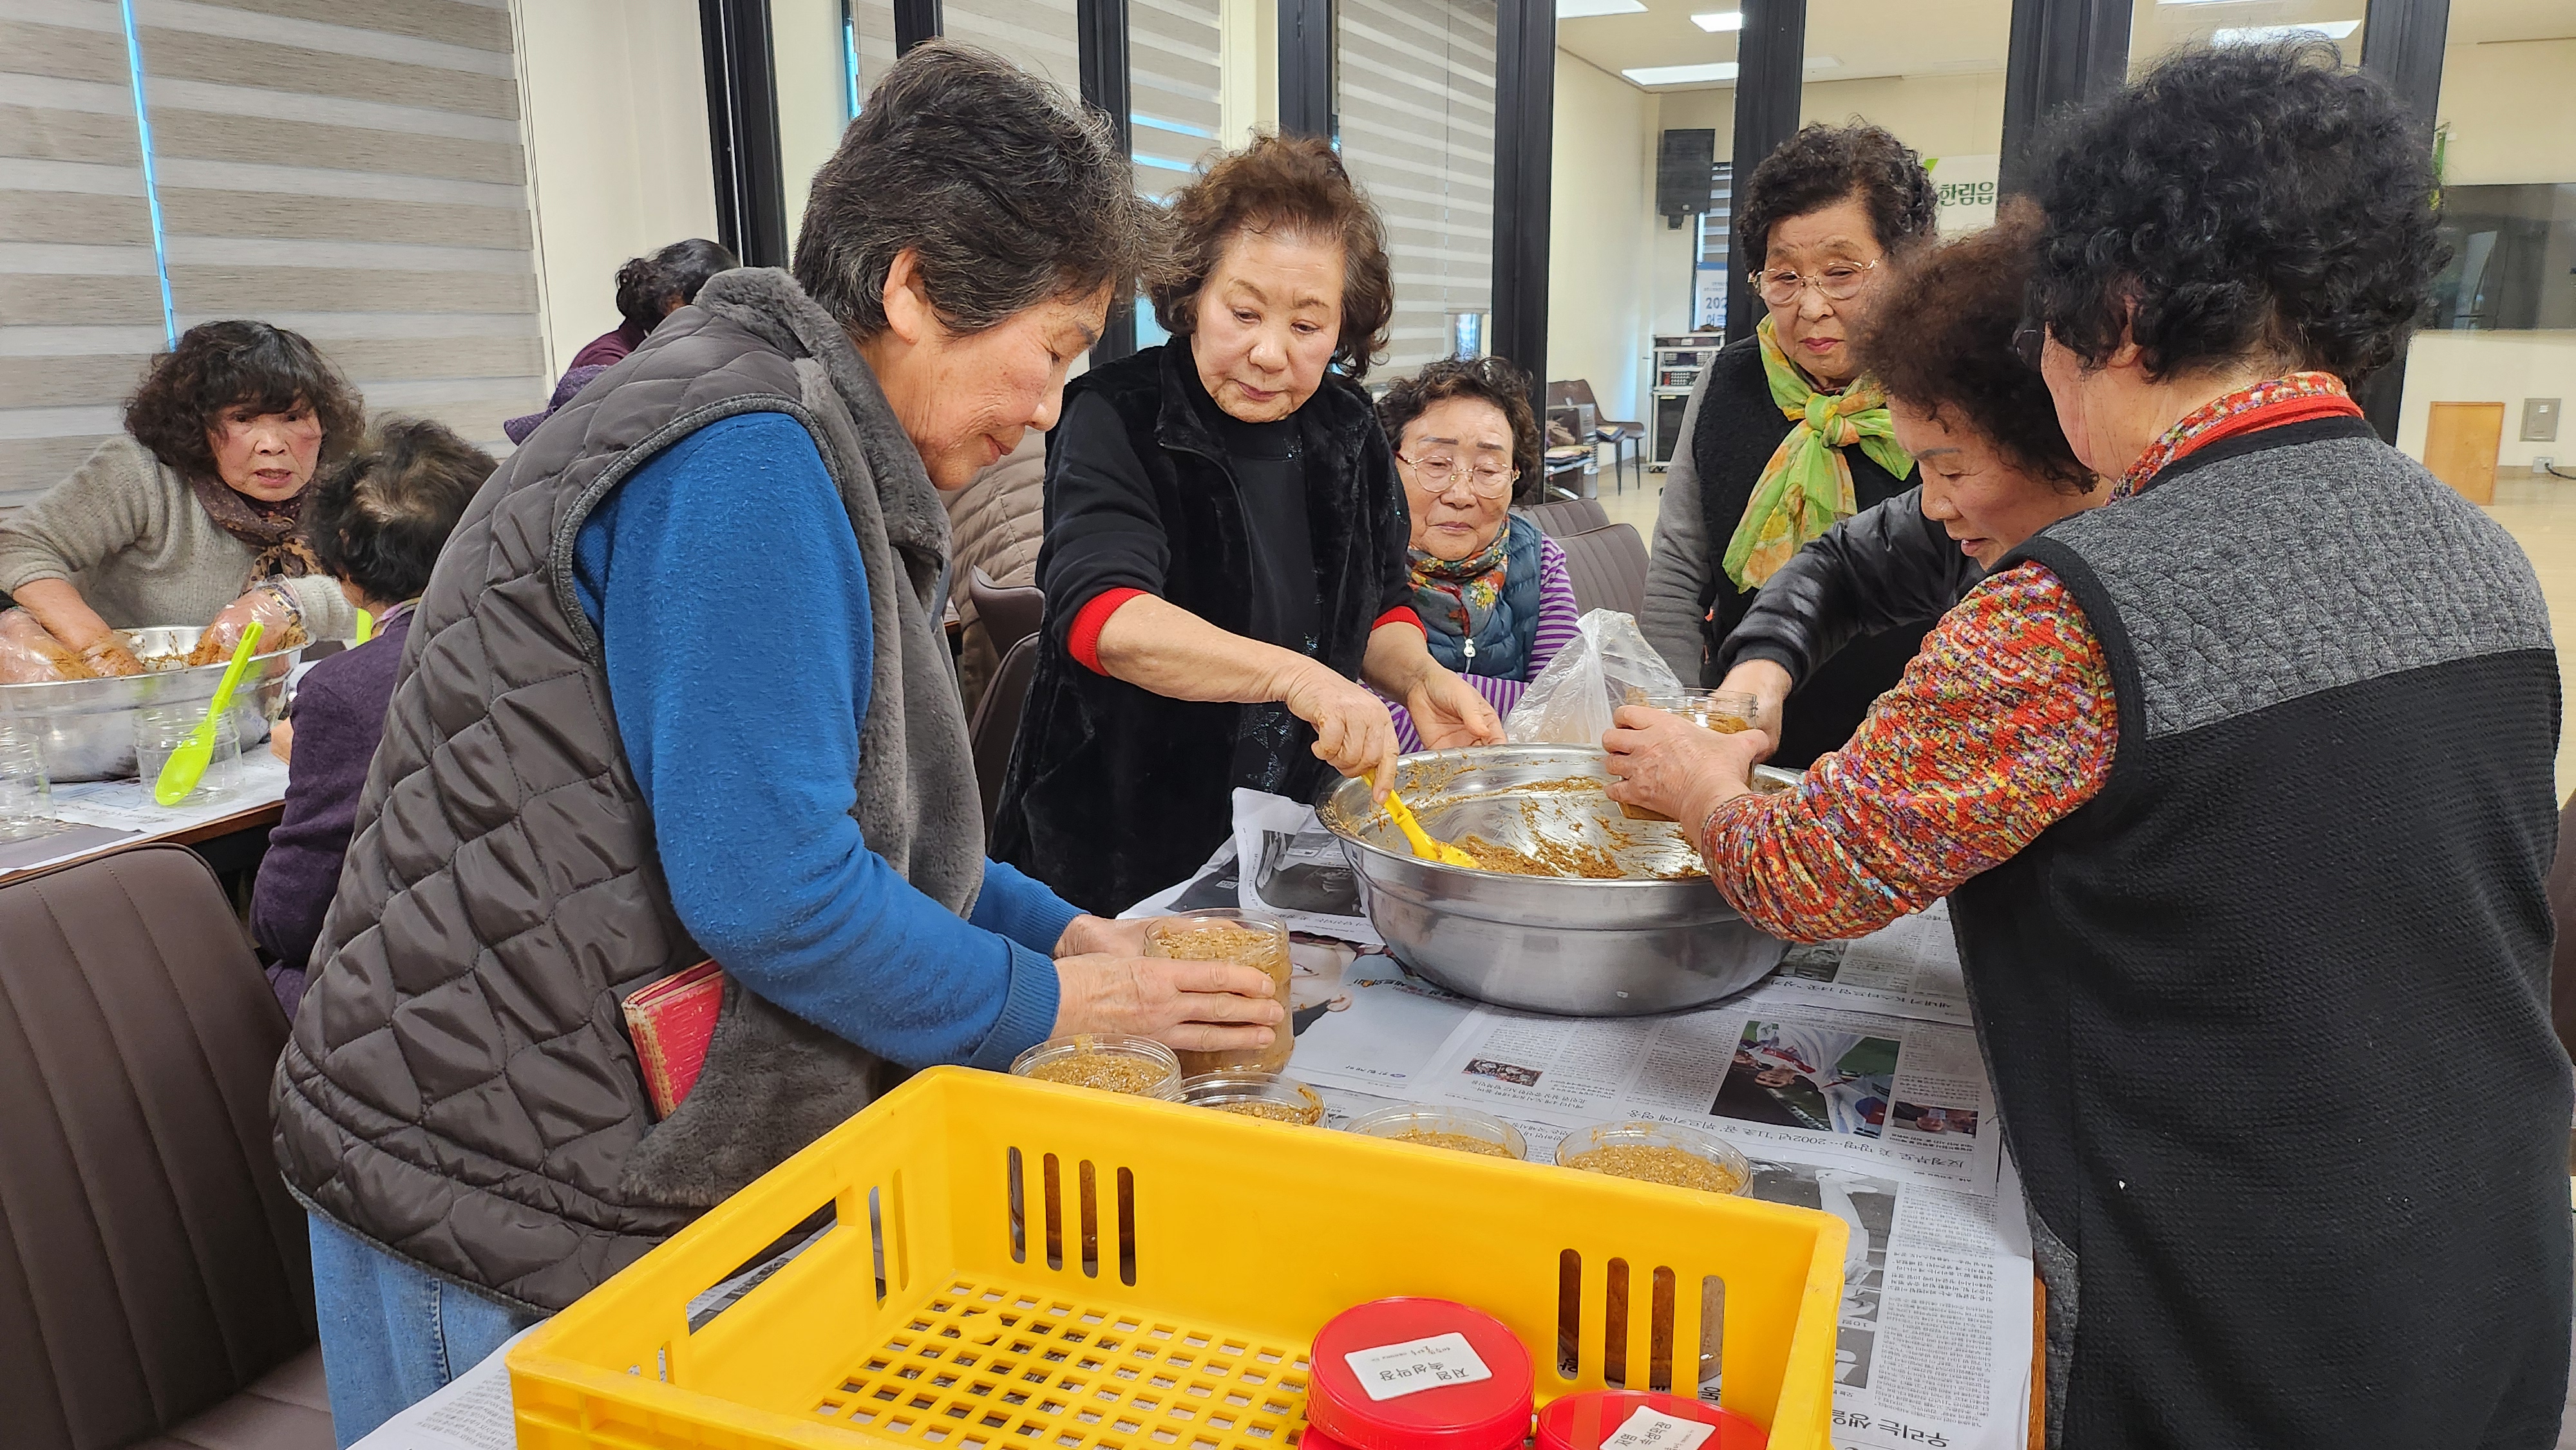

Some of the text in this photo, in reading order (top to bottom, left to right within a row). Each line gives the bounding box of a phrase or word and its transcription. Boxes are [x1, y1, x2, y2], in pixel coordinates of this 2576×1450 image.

[1939, 182, 1994, 207] 한림읍
[1705, 297, 1727, 309] 202
[1627, 1109, 1654, 1119] 영웅
[1778, 1132, 1827, 1147] 2002년
[1379, 1362, 1444, 1382] 속성막장
[1435, 1368, 1470, 1381] 저염
[1640, 1421, 1672, 1445] 속성막장
[1832, 1409, 1950, 1448] 우리는 생을
[1614, 1433, 1638, 1447] 저염
